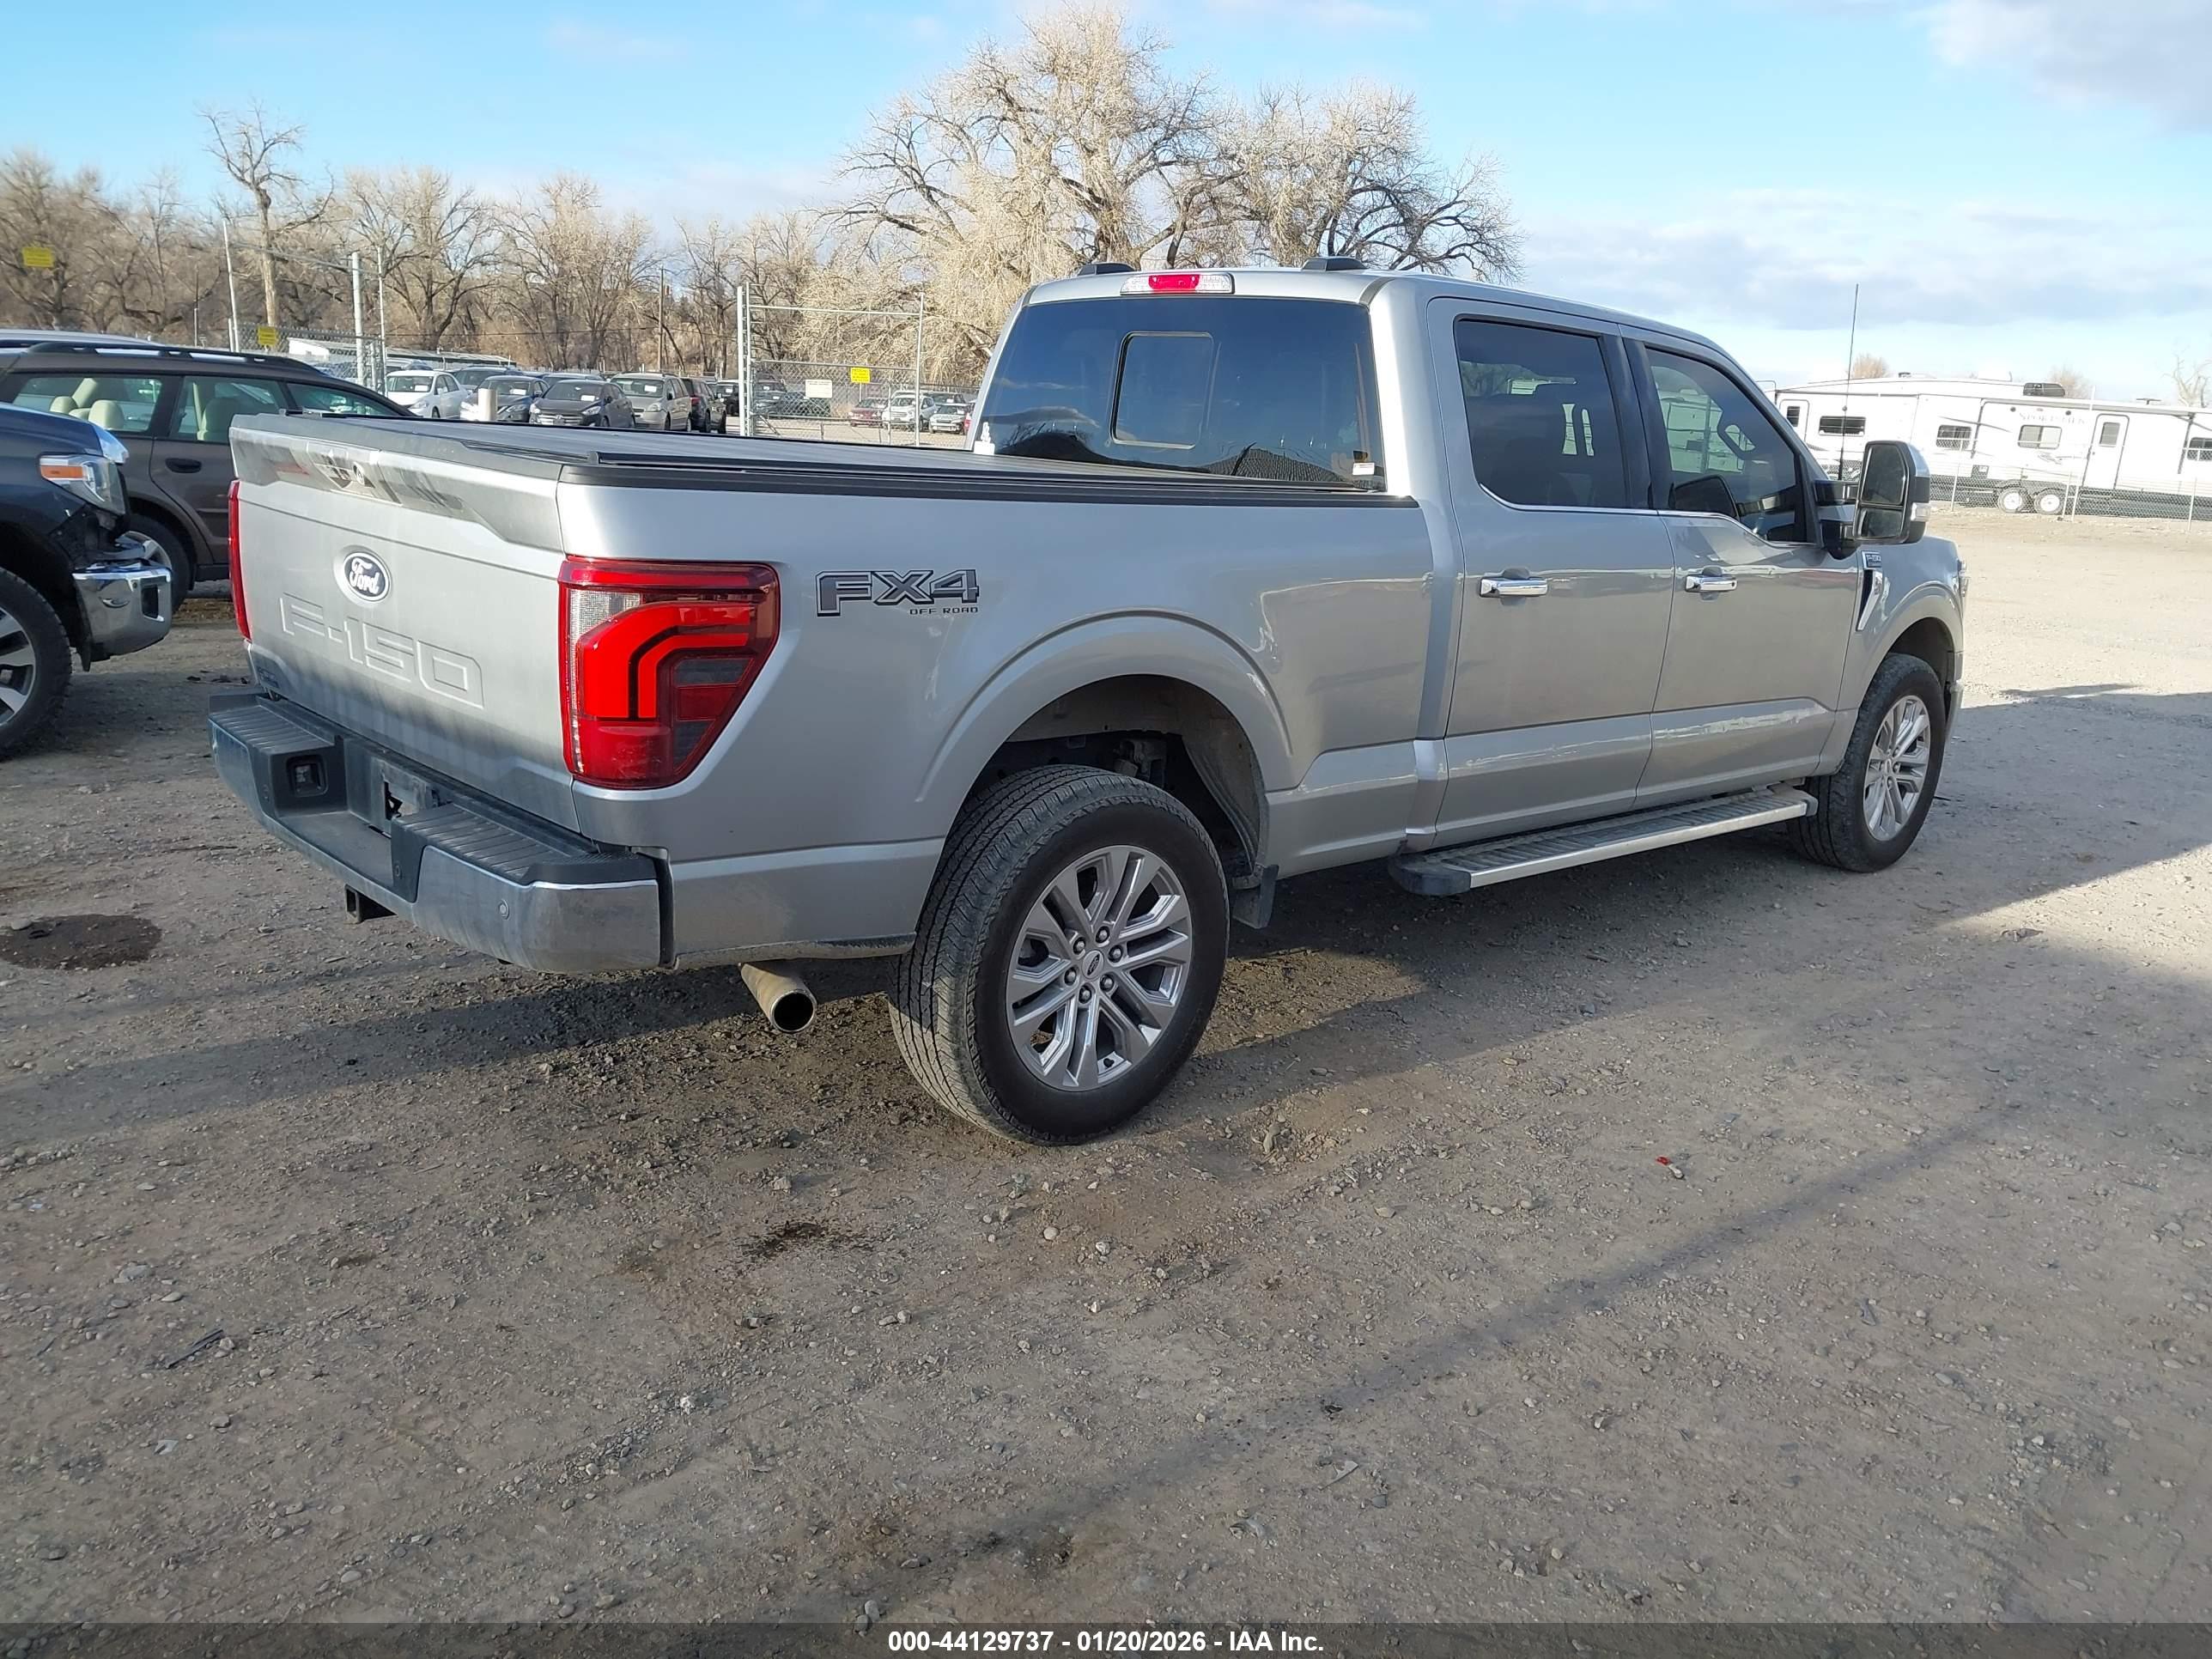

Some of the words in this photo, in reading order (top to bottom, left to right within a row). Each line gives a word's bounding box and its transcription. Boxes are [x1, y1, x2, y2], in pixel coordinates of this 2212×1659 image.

[349, 557, 380, 595] Ford
[816, 568, 980, 617] FX4
[942, 606, 979, 615] ROAD
[279, 592, 485, 709] F-150
